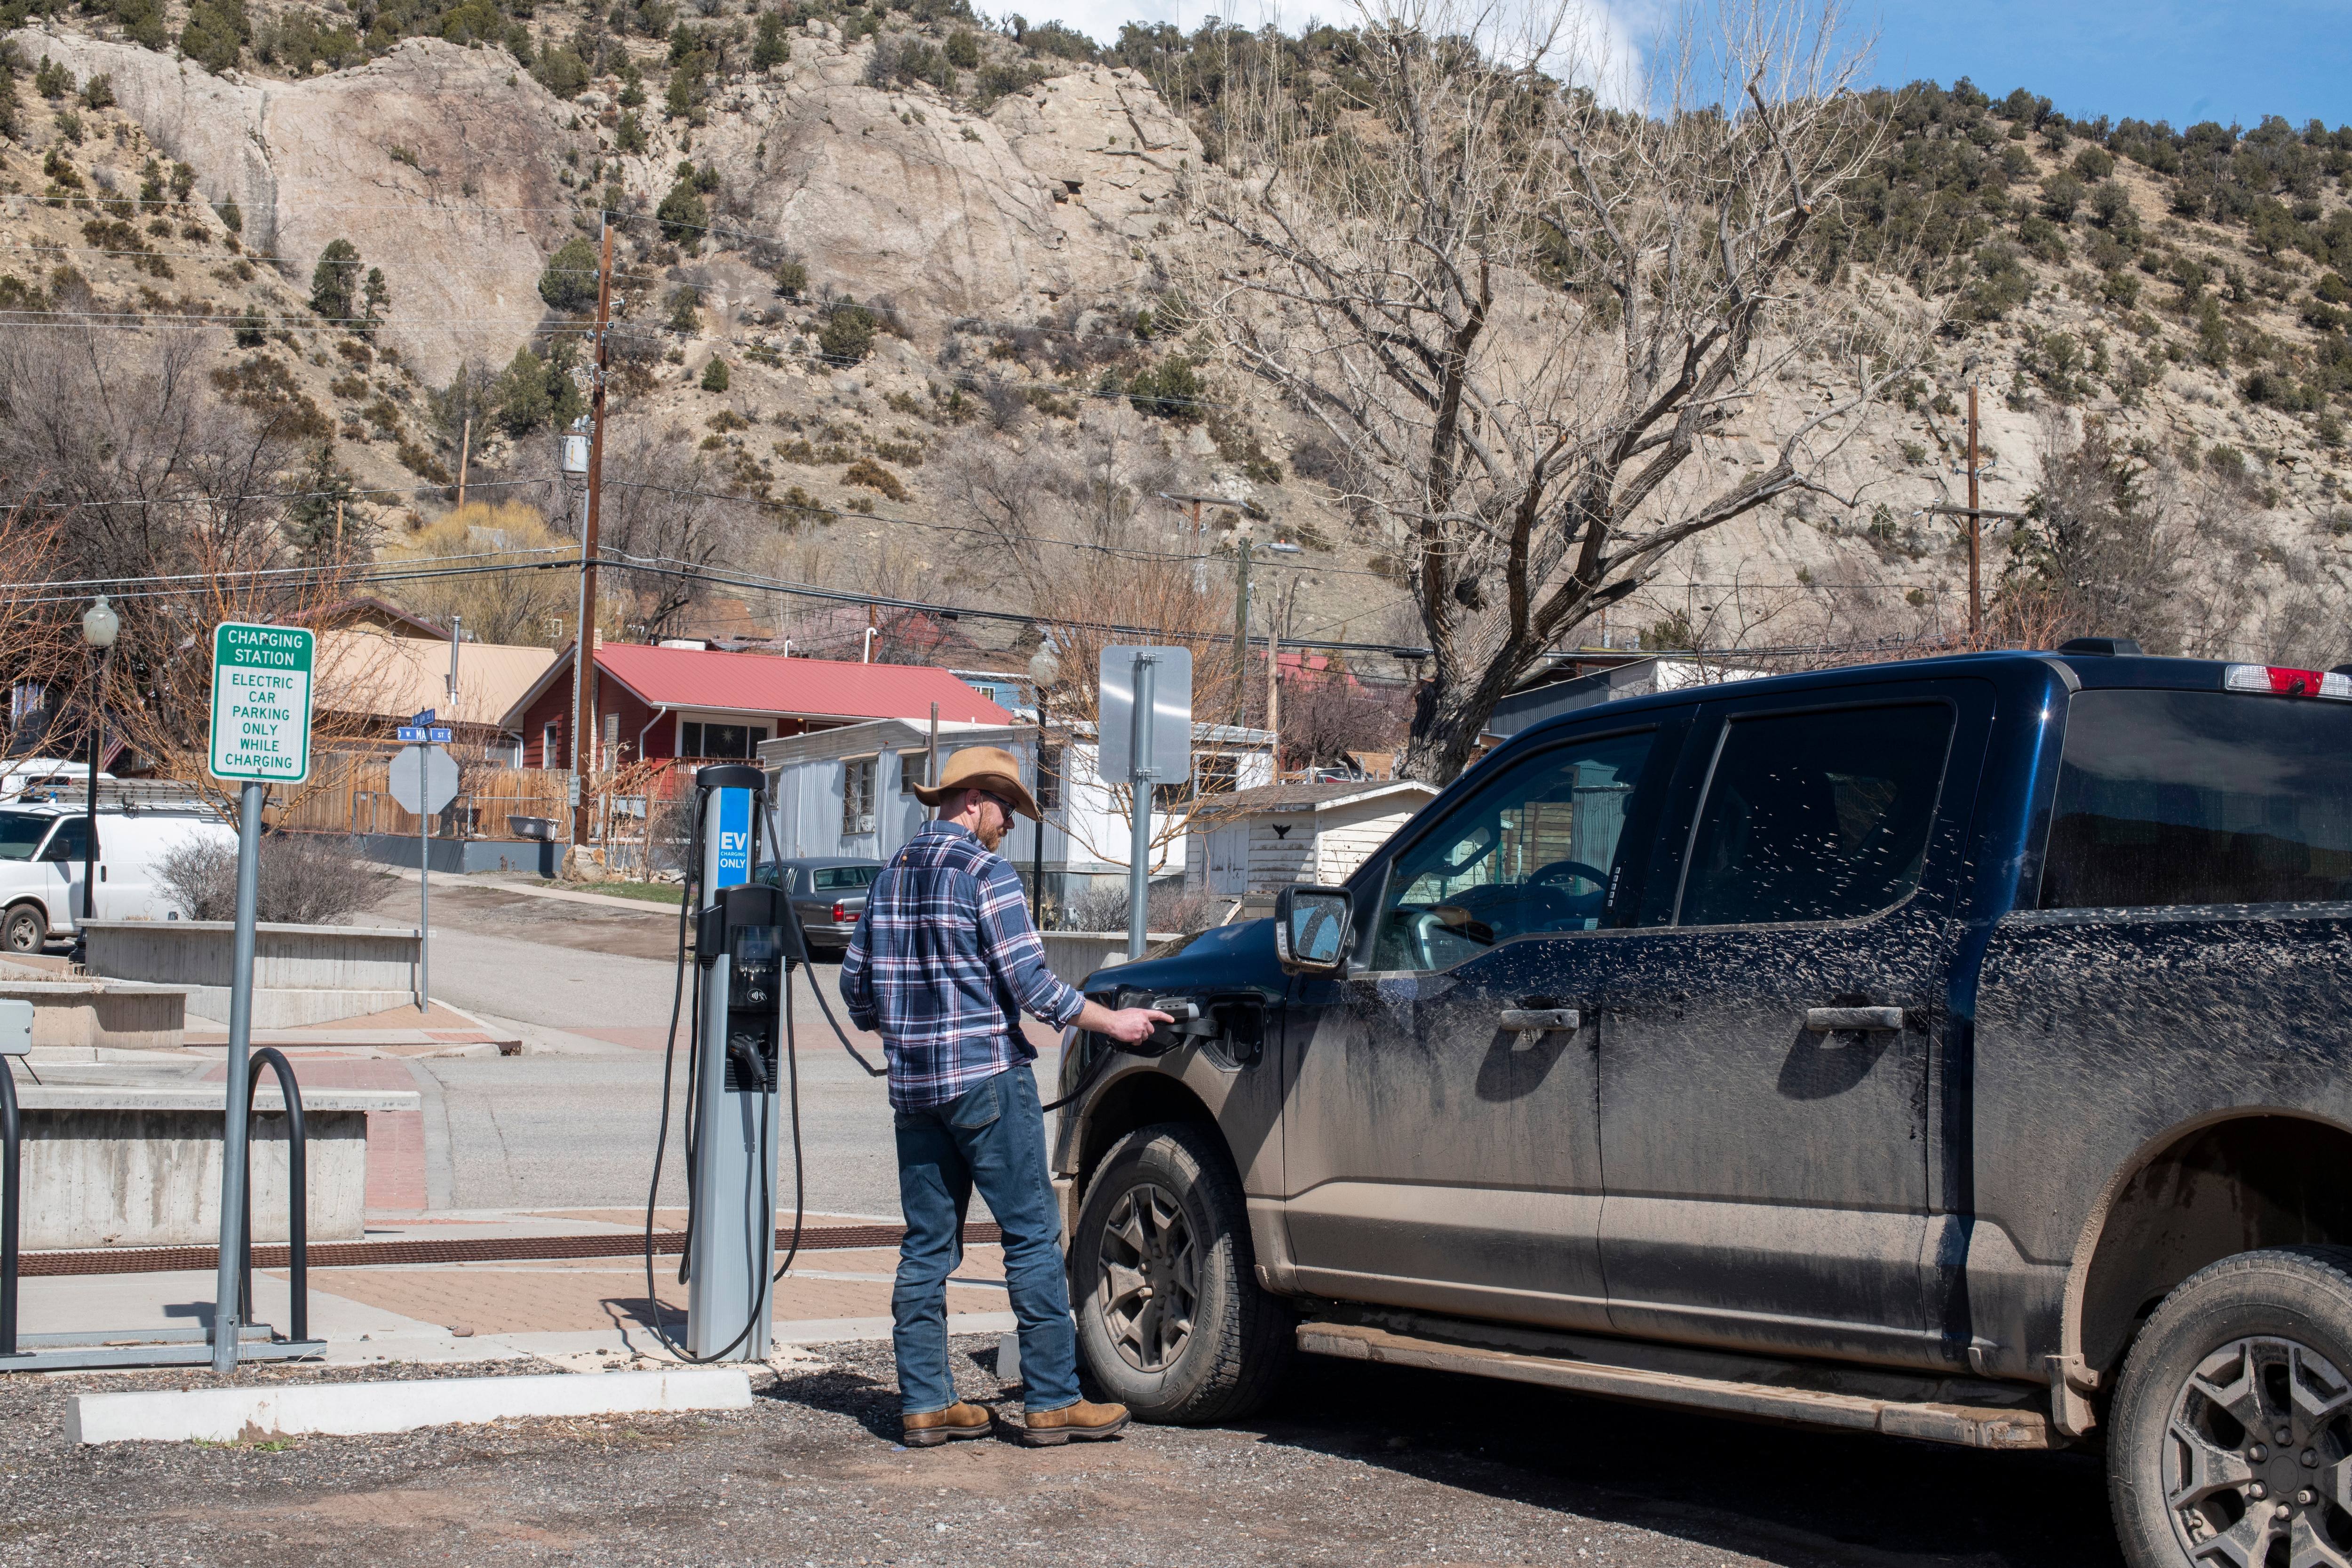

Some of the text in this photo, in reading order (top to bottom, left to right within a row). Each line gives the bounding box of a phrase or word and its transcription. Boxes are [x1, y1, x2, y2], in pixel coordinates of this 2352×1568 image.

[228, 630, 303, 649] CHARGING
[235, 649, 294, 666] STATION
[232, 673, 294, 689] ELECTRIC
[249, 691, 276, 704] CAR
[232, 705, 290, 721] PARKING
[243, 722, 278, 736] ONLY
[416, 729, 433, 740] MAIN
[240, 738, 279, 752] WHILE
[225, 753, 293, 768] CHARGING
[721, 832, 747, 850] EV
[720, 858, 746, 869] ONLY
[1203, 1259, 1214, 1330] 275/65R18
